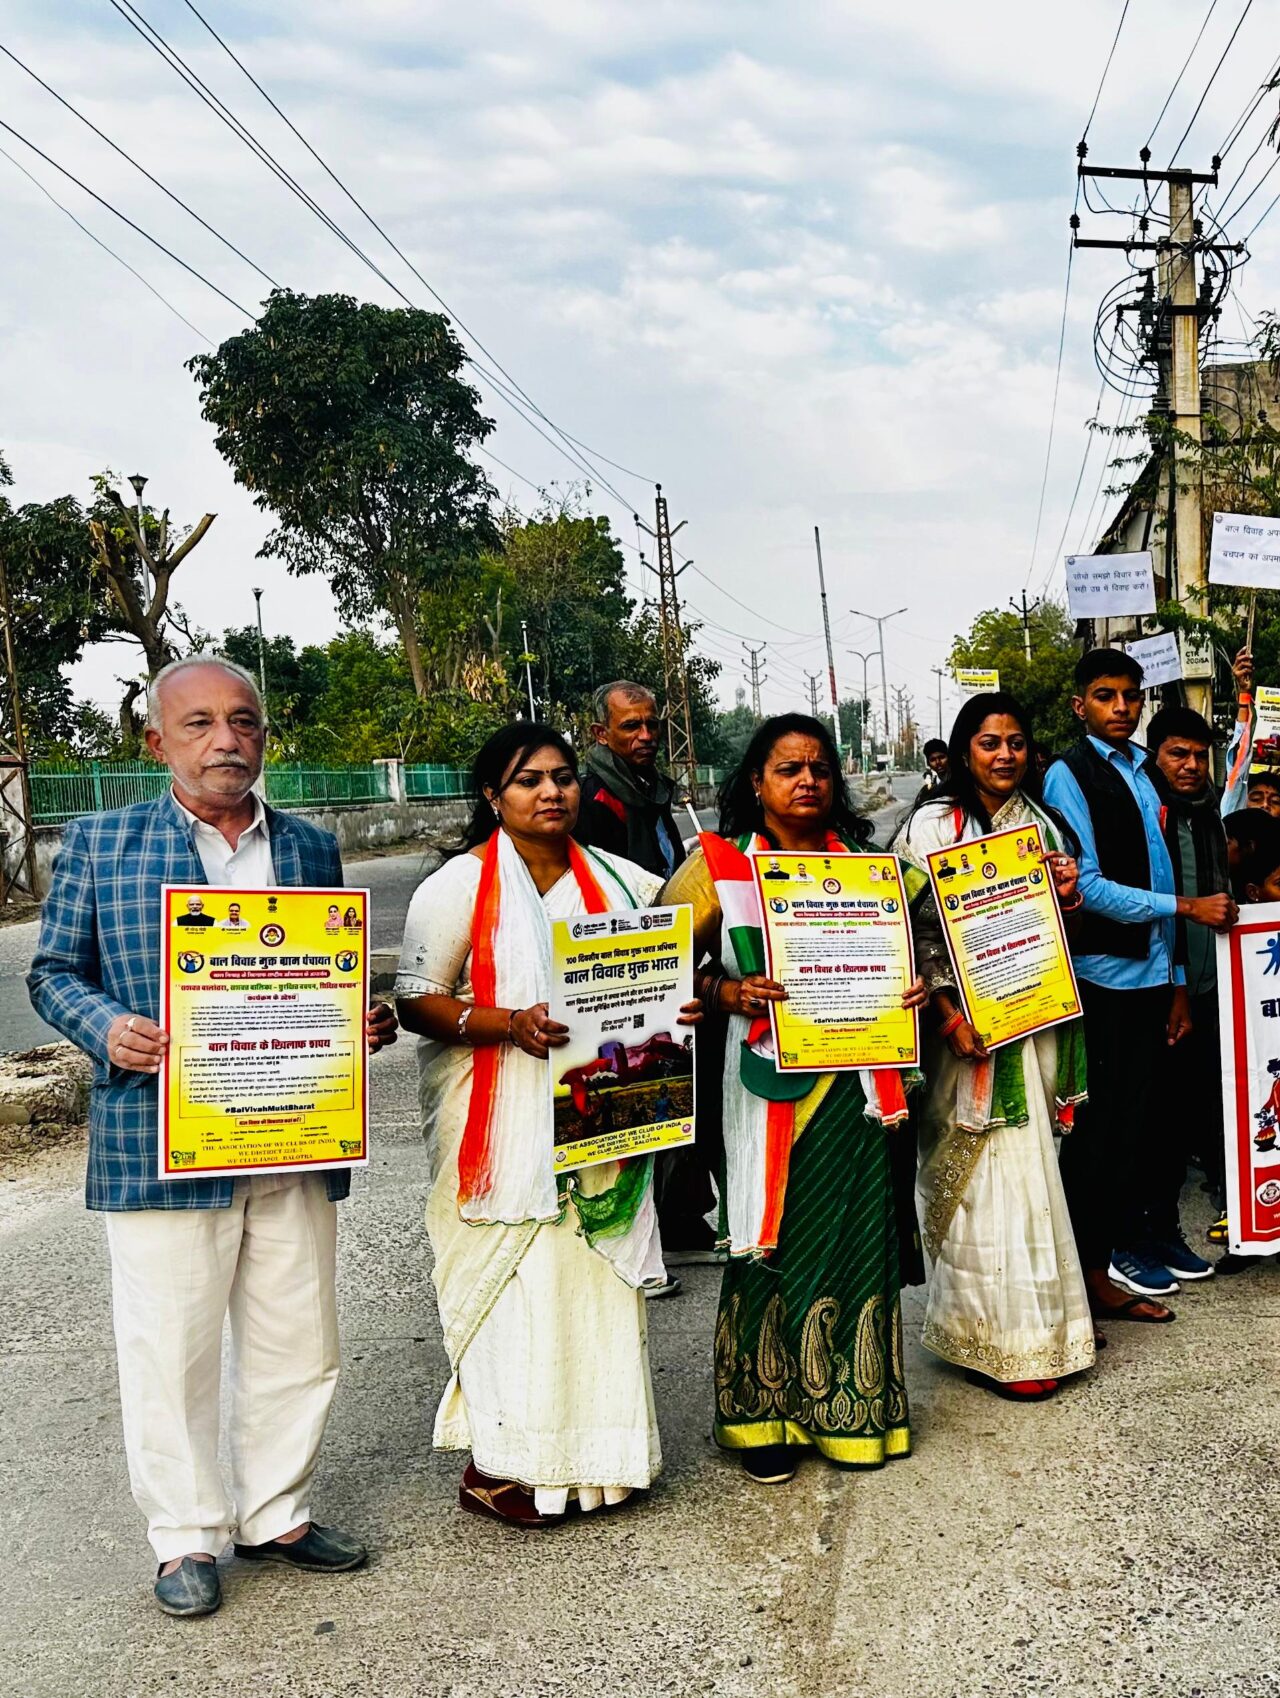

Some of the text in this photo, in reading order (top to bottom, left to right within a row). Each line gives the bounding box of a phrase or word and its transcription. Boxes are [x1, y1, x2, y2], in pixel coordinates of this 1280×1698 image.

[1243, 525, 1264, 536] विवाह
[601, 951, 612, 959] बाल
[614, 948, 629, 957] विवाह
[631, 947, 642, 958] मुक्त
[643, 945, 656, 954] भारत
[657, 942, 677, 951] अभियान
[210, 956, 228, 966] बाल
[231, 954, 257, 966] विवाह
[259, 956, 277, 969] मुक्त
[302, 954, 331, 966] पंचायत
[564, 956, 679, 984] बाल विवाह मुक्त भारत
[799, 966, 812, 974] बाल
[815, 965, 833, 973] विवाह
[834, 965, 841, 973] के
[208, 1042, 228, 1052] बाल
[231, 1040, 257, 1051] विवाह
[259, 1039, 269, 1050] के
[271, 1039, 307, 1050] खिलाफ
[225, 1103, 315, 1113] #BalVivahMuktBharat
[639, 1126, 655, 1134] CLUB
[666, 1121, 681, 1129] INDIA
